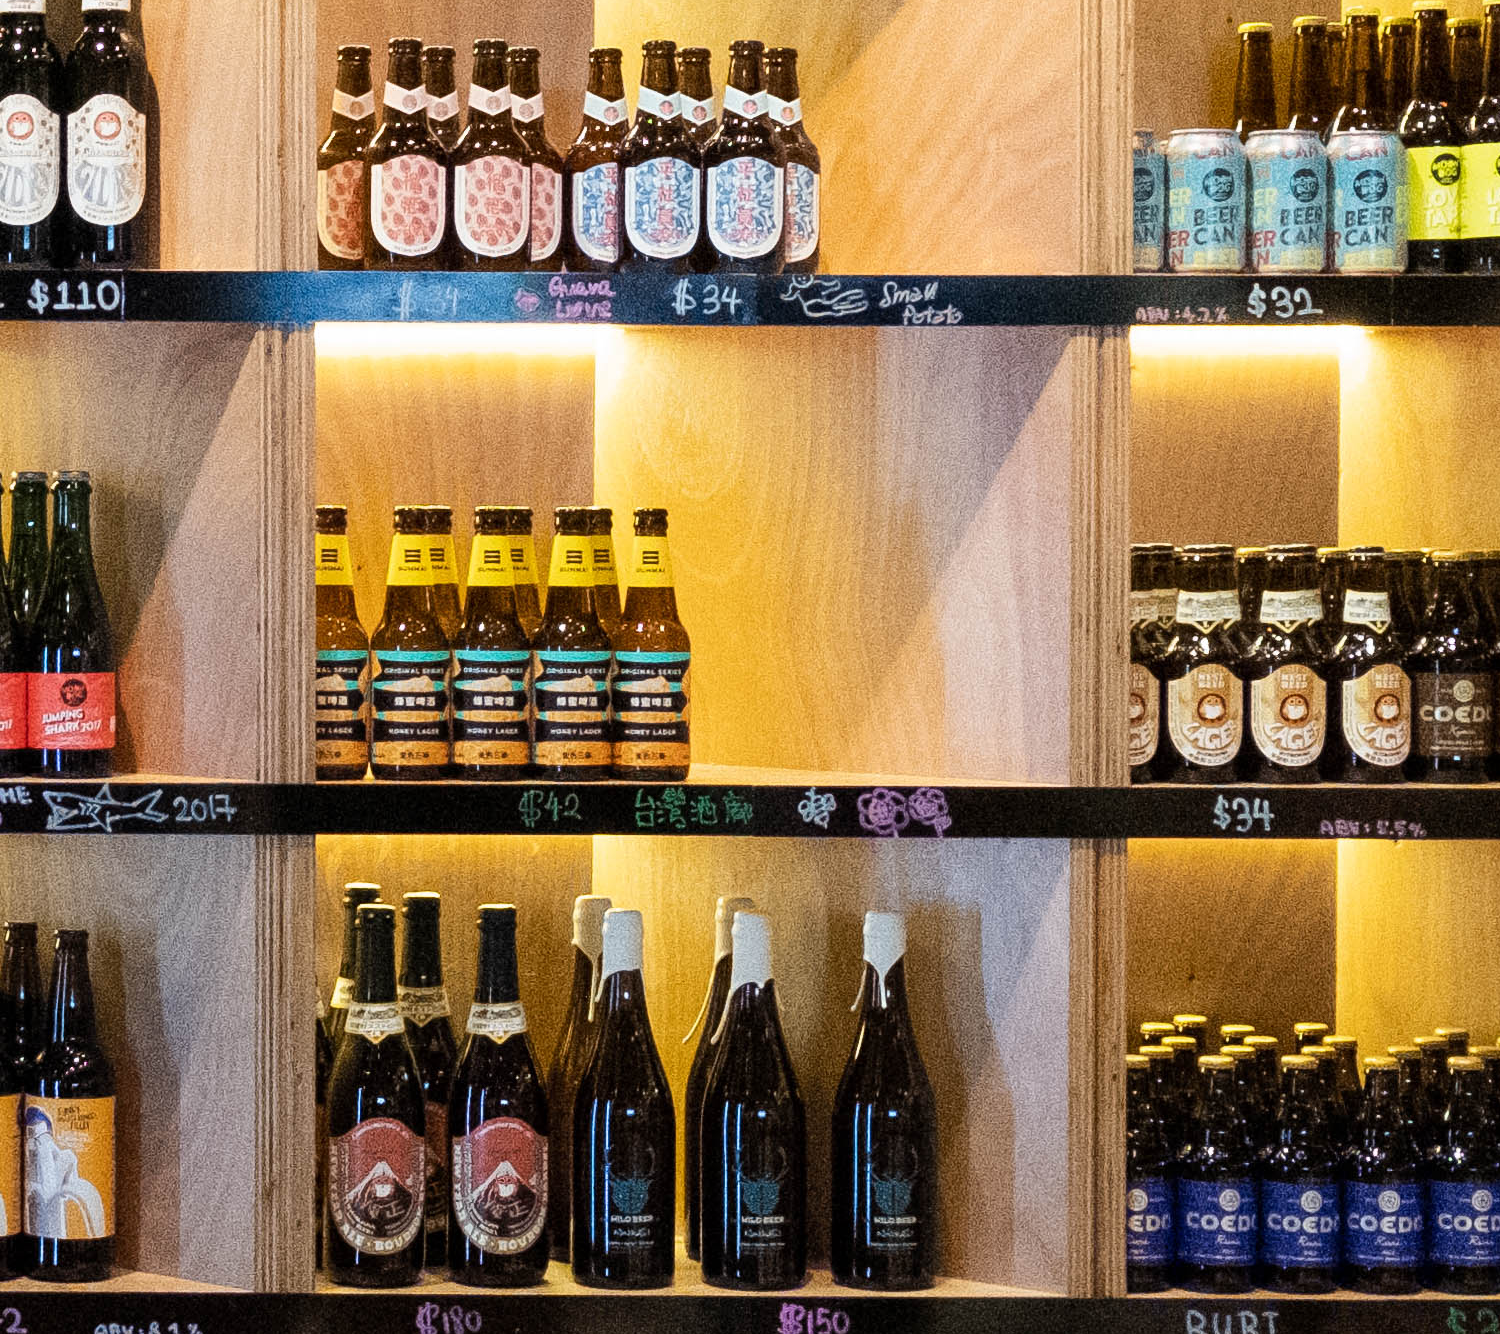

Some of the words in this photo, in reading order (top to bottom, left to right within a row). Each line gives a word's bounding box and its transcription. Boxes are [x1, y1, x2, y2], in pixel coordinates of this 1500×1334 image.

[1345, 206, 1393, 228] BEER
[1194, 227, 1235, 246] CAN
[1345, 227, 1389, 247] CAN
[27, 279, 120, 314] $110
[672, 279, 742, 315] $34
[1248, 283, 1323, 318] $32
[43, 709, 83, 722] JUMPING
[45, 722, 80, 735] SHARK
[174, 797, 236, 823] 2017
[518, 789, 581, 827] $42
[1213, 795, 1274, 832] $34
